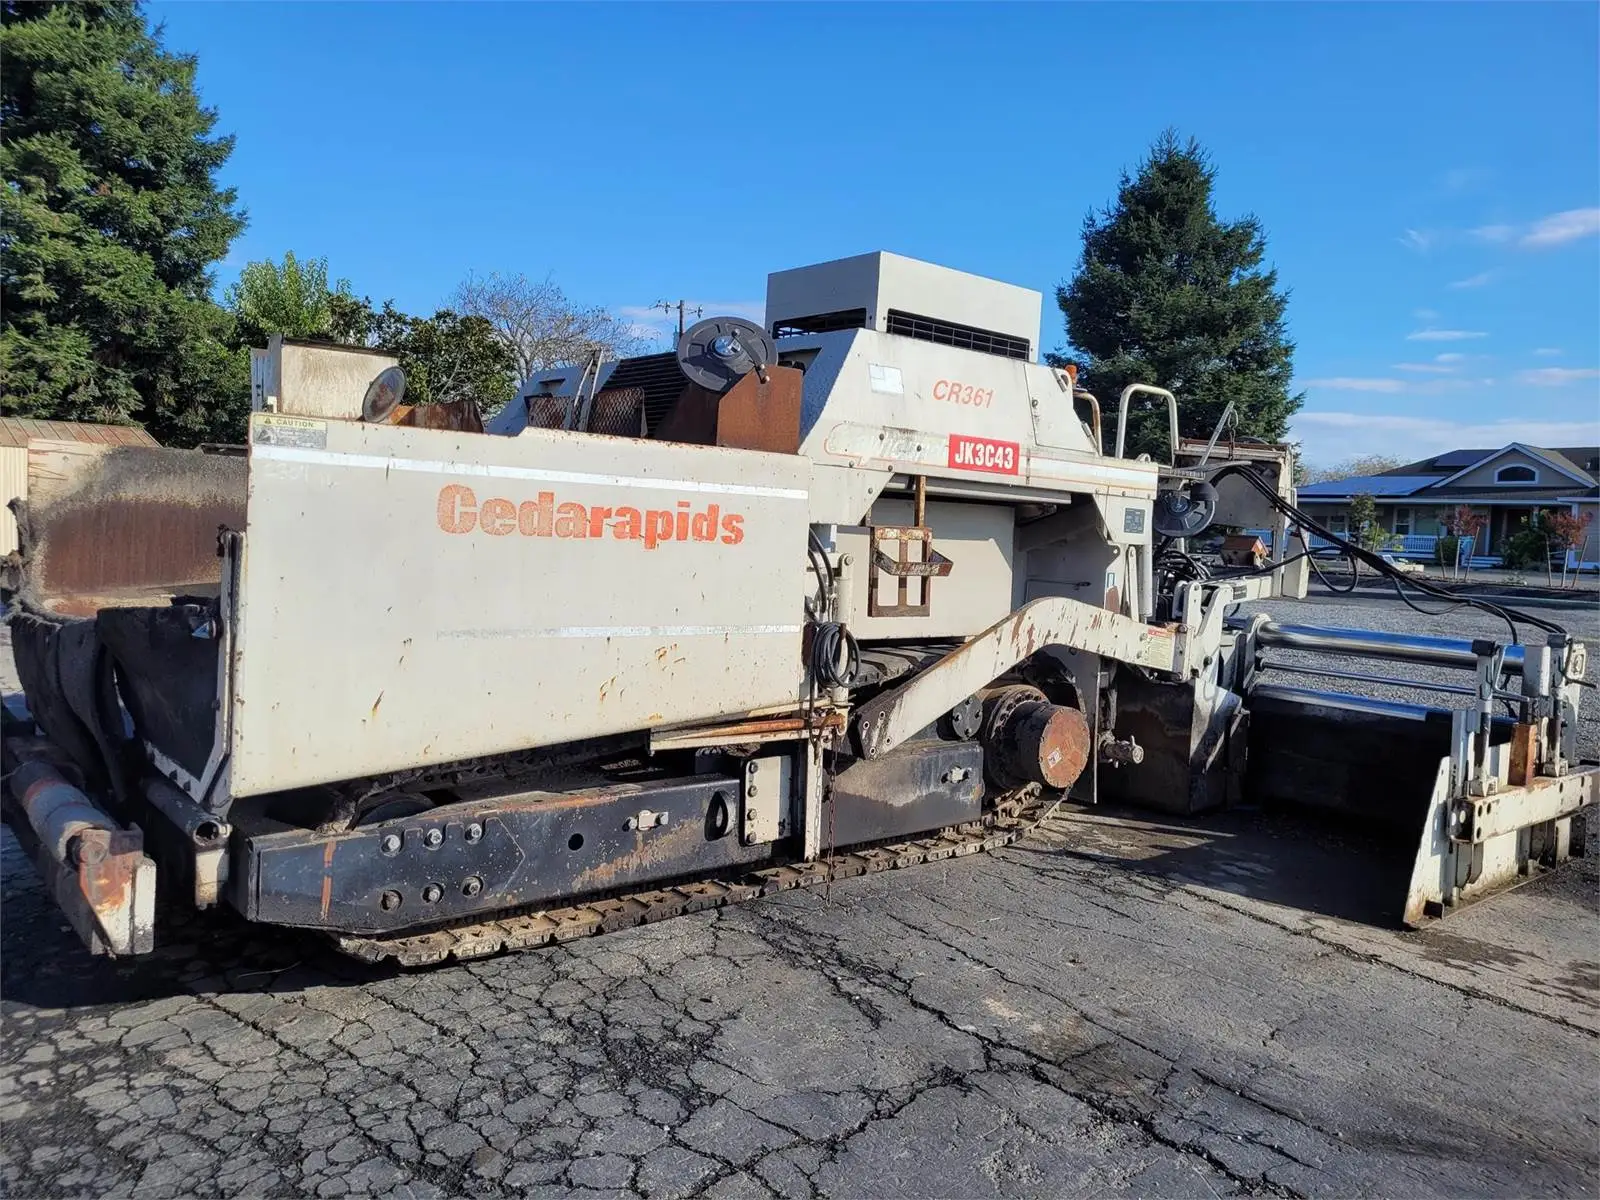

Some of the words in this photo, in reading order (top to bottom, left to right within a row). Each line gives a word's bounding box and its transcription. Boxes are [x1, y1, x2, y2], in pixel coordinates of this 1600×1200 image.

[933, 380, 995, 408] CR361
[276, 418, 314, 428] CAUTION
[954, 441, 1014, 470] JK3C43
[436, 484, 745, 550] Cedarapids
